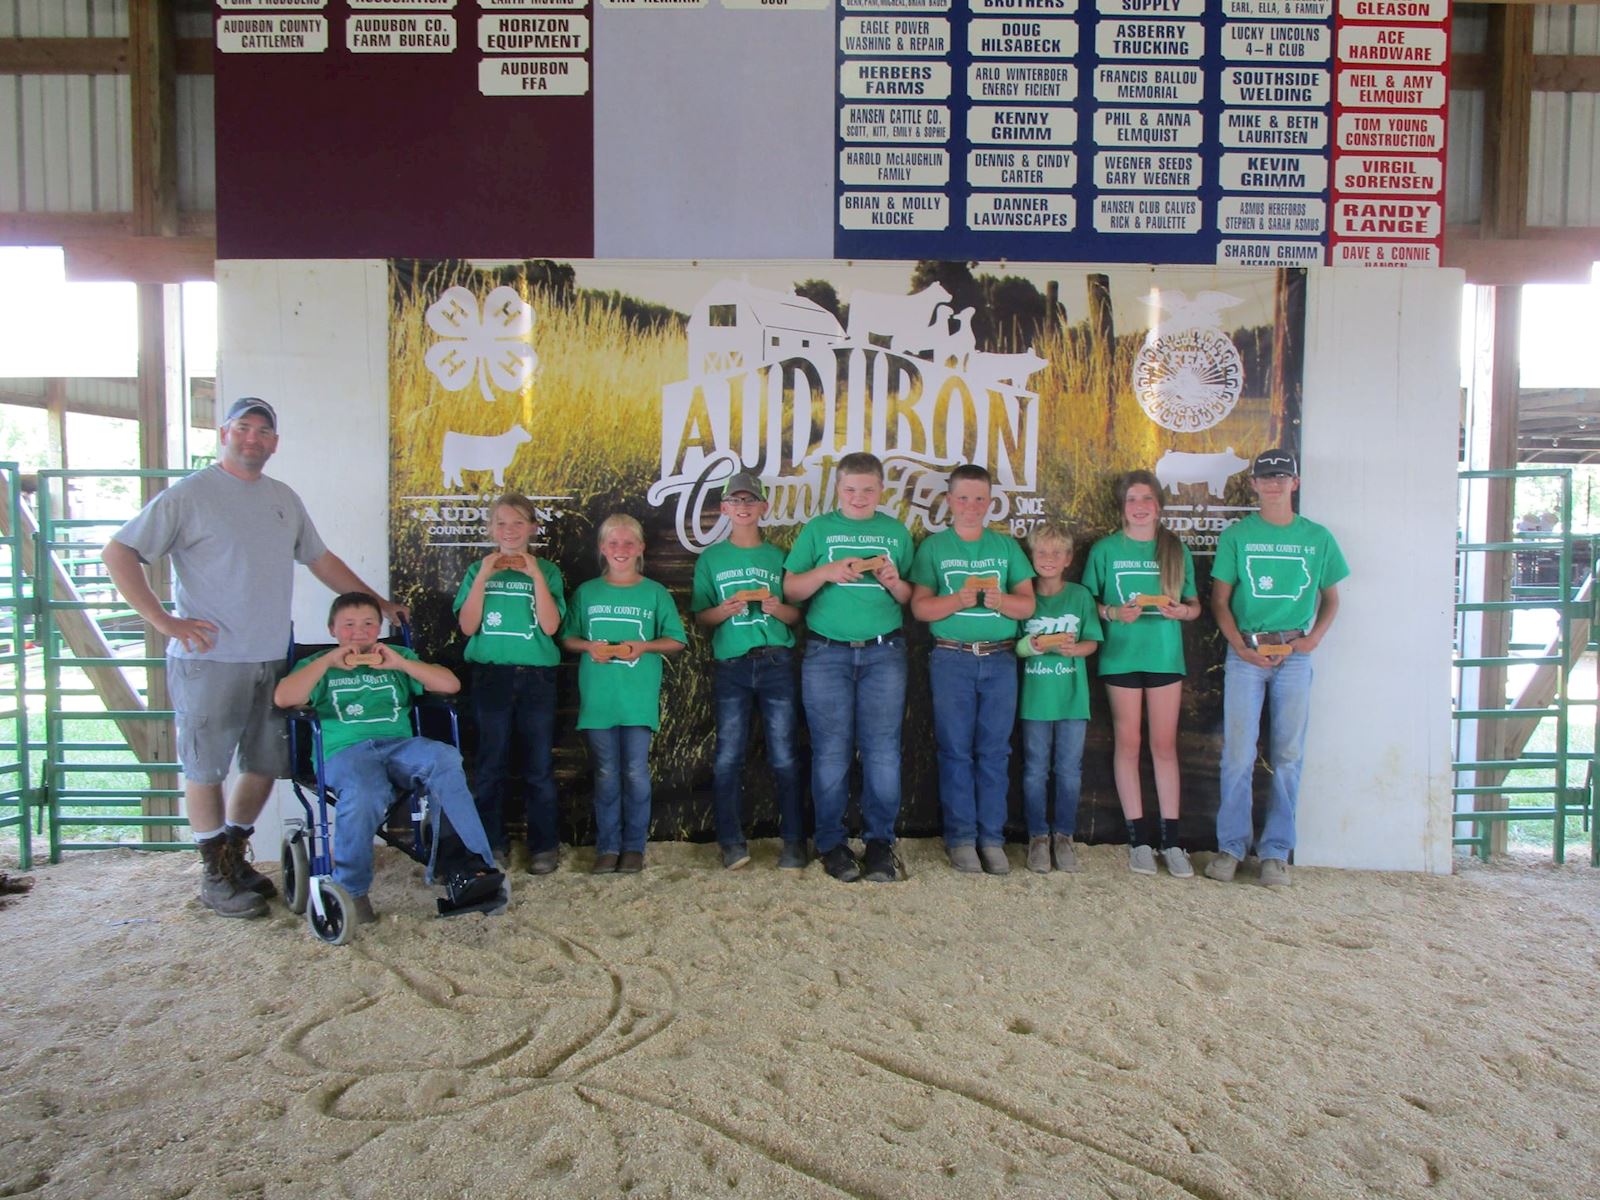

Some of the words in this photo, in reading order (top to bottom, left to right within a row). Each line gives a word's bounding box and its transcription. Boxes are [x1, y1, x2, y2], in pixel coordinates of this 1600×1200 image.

[1122, 0, 1181, 11] SUPPLY
[1231, 2, 1253, 14] EARL,
[1258, 2, 1280, 15] ELLA,
[1285, 3, 1291, 13] &
[1295, 2, 1324, 14] FAMILY
[1357, 2, 1430, 16] GLEASON
[224, 20, 273, 33] AUDUBON
[280, 20, 322, 33] COUNTY
[355, 19, 415, 32] AUDUBON
[425, 19, 448, 32] CO.
[499, 18, 569, 33] HORIZON
[860, 21, 889, 34] EAGLE
[895, 21, 929, 34] POWER
[1002, 23, 1041, 37] DOUG
[1116, 24, 1186, 39] ASBERRY
[353, 34, 390, 47] FARM
[399, 34, 450, 47] BUREAU
[1231, 27, 1264, 40] LUCKY
[1270, 27, 1320, 41] LINCOLNS
[1377, 31, 1405, 44] ACE
[241, 35, 304, 48] CATTLEMEN
[487, 34, 581, 49] EQUIPMENT
[846, 37, 891, 51] WASHING
[897, 38, 904, 50] &
[911, 38, 944, 51] REPAIR
[981, 39, 1061, 53] HILSABECK
[1113, 40, 1189, 55] TRUCKING
[1279, 43, 1305, 57] CLUB
[1349, 45, 1432, 61] HARDWARE
[501, 62, 569, 75] AUDUBON
[859, 66, 932, 80] HERBERS
[975, 68, 1000, 80] ARLO
[1006, 68, 1068, 82] WINTERBOER
[522, 77, 547, 90] FFA
[1100, 70, 1148, 84] FRANCIS
[1155, 71, 1197, 85] BALLOU
[1232, 71, 1319, 86] SOUTHSIDE
[1350, 74, 1377, 88] NEIL
[1386, 75, 1395, 88] &
[1403, 76, 1433, 88] AMY
[866, 81, 924, 95] FARMS
[982, 83, 1019, 96] ENERGY
[1025, 84, 1061, 96] FICIENT
[1118, 85, 1178, 99] MEMORIAL
[1240, 87, 1312, 102] WELDING
[1359, 90, 1423, 104] ELMQUIST
[850, 109, 885, 124] HANSEN
[890, 109, 922, 124] CATTLE
[927, 110, 942, 125] CO.
[994, 112, 1049, 125] KENNY
[1105, 112, 1131, 126] PHIL
[1140, 113, 1149, 126] &
[1156, 113, 1191, 127] ANNA
[1228, 115, 1261, 128] MIKE
[1269, 115, 1278, 128] &
[1287, 116, 1318, 129] BETH
[1355, 118, 1380, 131] TOM
[1389, 119, 1427, 132] YOUNG
[892, 127, 912, 137] EMILY
[916, 127, 921, 138] &
[924, 127, 946, 138] SOPHIE
[991, 127, 1051, 140] GRIMM
[1117, 128, 1178, 143] ELMQUIST
[1238, 130, 1308, 144] LAURITSEN
[1346, 133, 1435, 147] CONSTRUCTION
[847, 152, 881, 165] HAROLD
[886, 153, 943, 166] McLAUGHLIN
[975, 154, 1015, 167] DENNIS
[1022, 155, 1029, 167] &
[1037, 154, 1070, 168] CINDY
[1105, 156, 1152, 170] WEGNER
[1158, 157, 1193, 170] SEEDS
[1248, 157, 1299, 171] KEVIN
[878, 168, 911, 181] FAMILY
[1362, 161, 1416, 174] VIRGIL
[1001, 170, 1044, 183] CARTER
[1106, 172, 1136, 185] GARY
[1144, 172, 1190, 185] WEGNER
[1240, 173, 1305, 188] GRIMM
[1345, 175, 1433, 189] SORENSEN
[845, 197, 880, 209] BRIAN
[887, 197, 896, 209] &
[902, 197, 941, 210] MOLLY
[993, 198, 1048, 211] DANNER
[1101, 201, 1134, 214] HANSEN
[1139, 201, 1160, 214] CLUB
[1165, 202, 1196, 215] CALVES
[1240, 202, 1265, 215] ASMUS
[1268, 203, 1306, 215] HEREFORDS
[1343, 204, 1431, 218] RANDY
[871, 212, 914, 225] KLOCKE
[974, 213, 1068, 226] LAWNSCAPES
[1110, 216, 1130, 229] RICK
[1135, 216, 1141, 229] &
[1146, 216, 1186, 229] PAULETTE
[1225, 218, 1256, 230] STEPHEN
[1259, 218, 1264, 230] &
[1268, 218, 1291, 230] SARAH
[1294, 218, 1319, 231] ASMUS
[1346, 219, 1428, 233] LANGE
[1224, 245, 1270, 258] SHARON
[1277, 246, 1318, 259] GRIMM
[1343, 246, 1370, 259] DAVE
[1377, 247, 1384, 260] &
[1391, 247, 1430, 260] CONNIE
[667, 346, 1032, 487] AUDUBON
[429, 526, 475, 535] COUNTY
